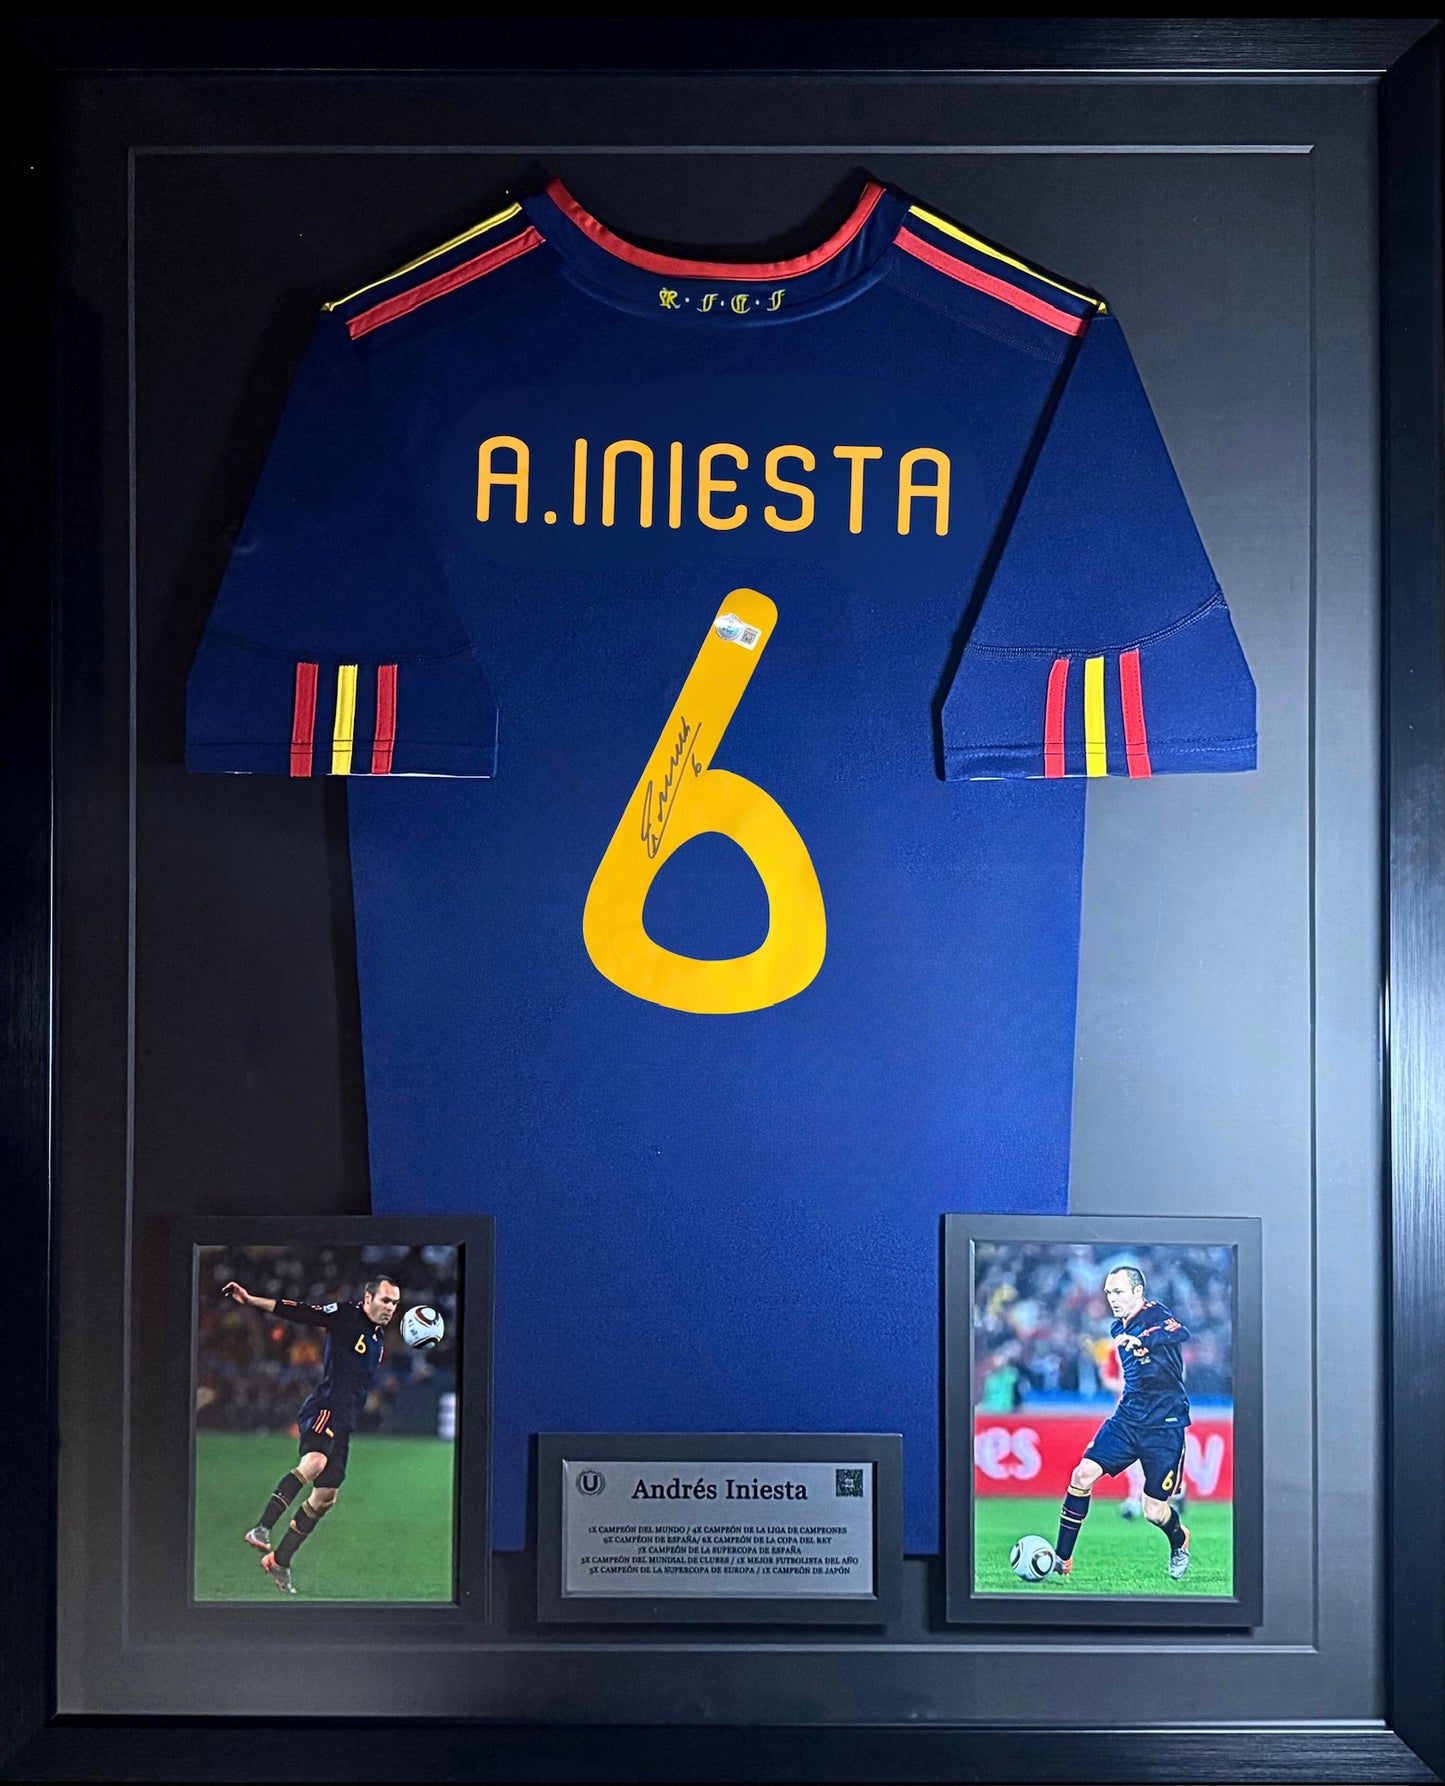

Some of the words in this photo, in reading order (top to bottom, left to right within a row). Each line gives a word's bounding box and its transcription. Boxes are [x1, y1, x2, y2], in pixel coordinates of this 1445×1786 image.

[475, 435, 952, 537] A.INIESTA
[583, 588, 827, 1015] 6
[354, 1333, 368, 1355] 6
[583, 1474, 598, 1492] U
[631, 1477, 718, 1500] Andrés
[725, 1478, 809, 1501] Iniesta
[1161, 1469, 1175, 1492] 6
[598, 1525, 636, 1534] CAMPEÓN
[638, 1525, 654, 1534] DEL
[656, 1525, 686, 1534] MUNDO
[704, 1525, 742, 1534] CAMPEÓN
[744, 1525, 754, 1534] DE
[756, 1525, 765, 1534] LA
[767, 1525, 786, 1534] LIGA
[788, 1525, 798, 1534] DE
[800, 1525, 847, 1534] CAMPEONES
[655, 1535, 665, 1544] DE
[714, 1535, 751, 1544] CAMPEÓN
[754, 1535, 764, 1544] DE
[766, 1535, 776, 1544] LA
[777, 1535, 798, 1544] COPA
[800, 1536, 815, 1545] DEL
[816, 1536, 832, 1545] REY
[648, 1545, 686, 1554] CAMPEÓN
[688, 1545, 699, 1554] DE
[701, 1545, 710, 1554] LA
[712, 1545, 757, 1554] SUPERCOPA
[759, 1545, 770, 1554] DE
[772, 1545, 802, 1554] ESPAÑA
[592, 1555, 629, 1564] CAMPEÓN
[632, 1556, 647, 1564] DEL
[649, 1556, 686, 1564] MUNDIAL
[688, 1556, 698, 1564] DE
[700, 1556, 729, 1564] CLUBES
[747, 1556, 773, 1564] MEJOR
[776, 1556, 823, 1564] FUTBOLISTA
[825, 1556, 840, 1564] DEL
[842, 1556, 858, 1564] AÑO
[601, 1565, 638, 1574] CAMPEÓN
[640, 1566, 651, 1574] DE
[653, 1566, 662, 1574] LA
[664, 1566, 709, 1574] SUPERCOPA
[711, 1566, 722, 1574] DE
[724, 1566, 755, 1574] EUROPA
[772, 1566, 811, 1574] CAMPEÓN
[813, 1566, 823, 1574] DE
[825, 1566, 850, 1574] JAPÓN
